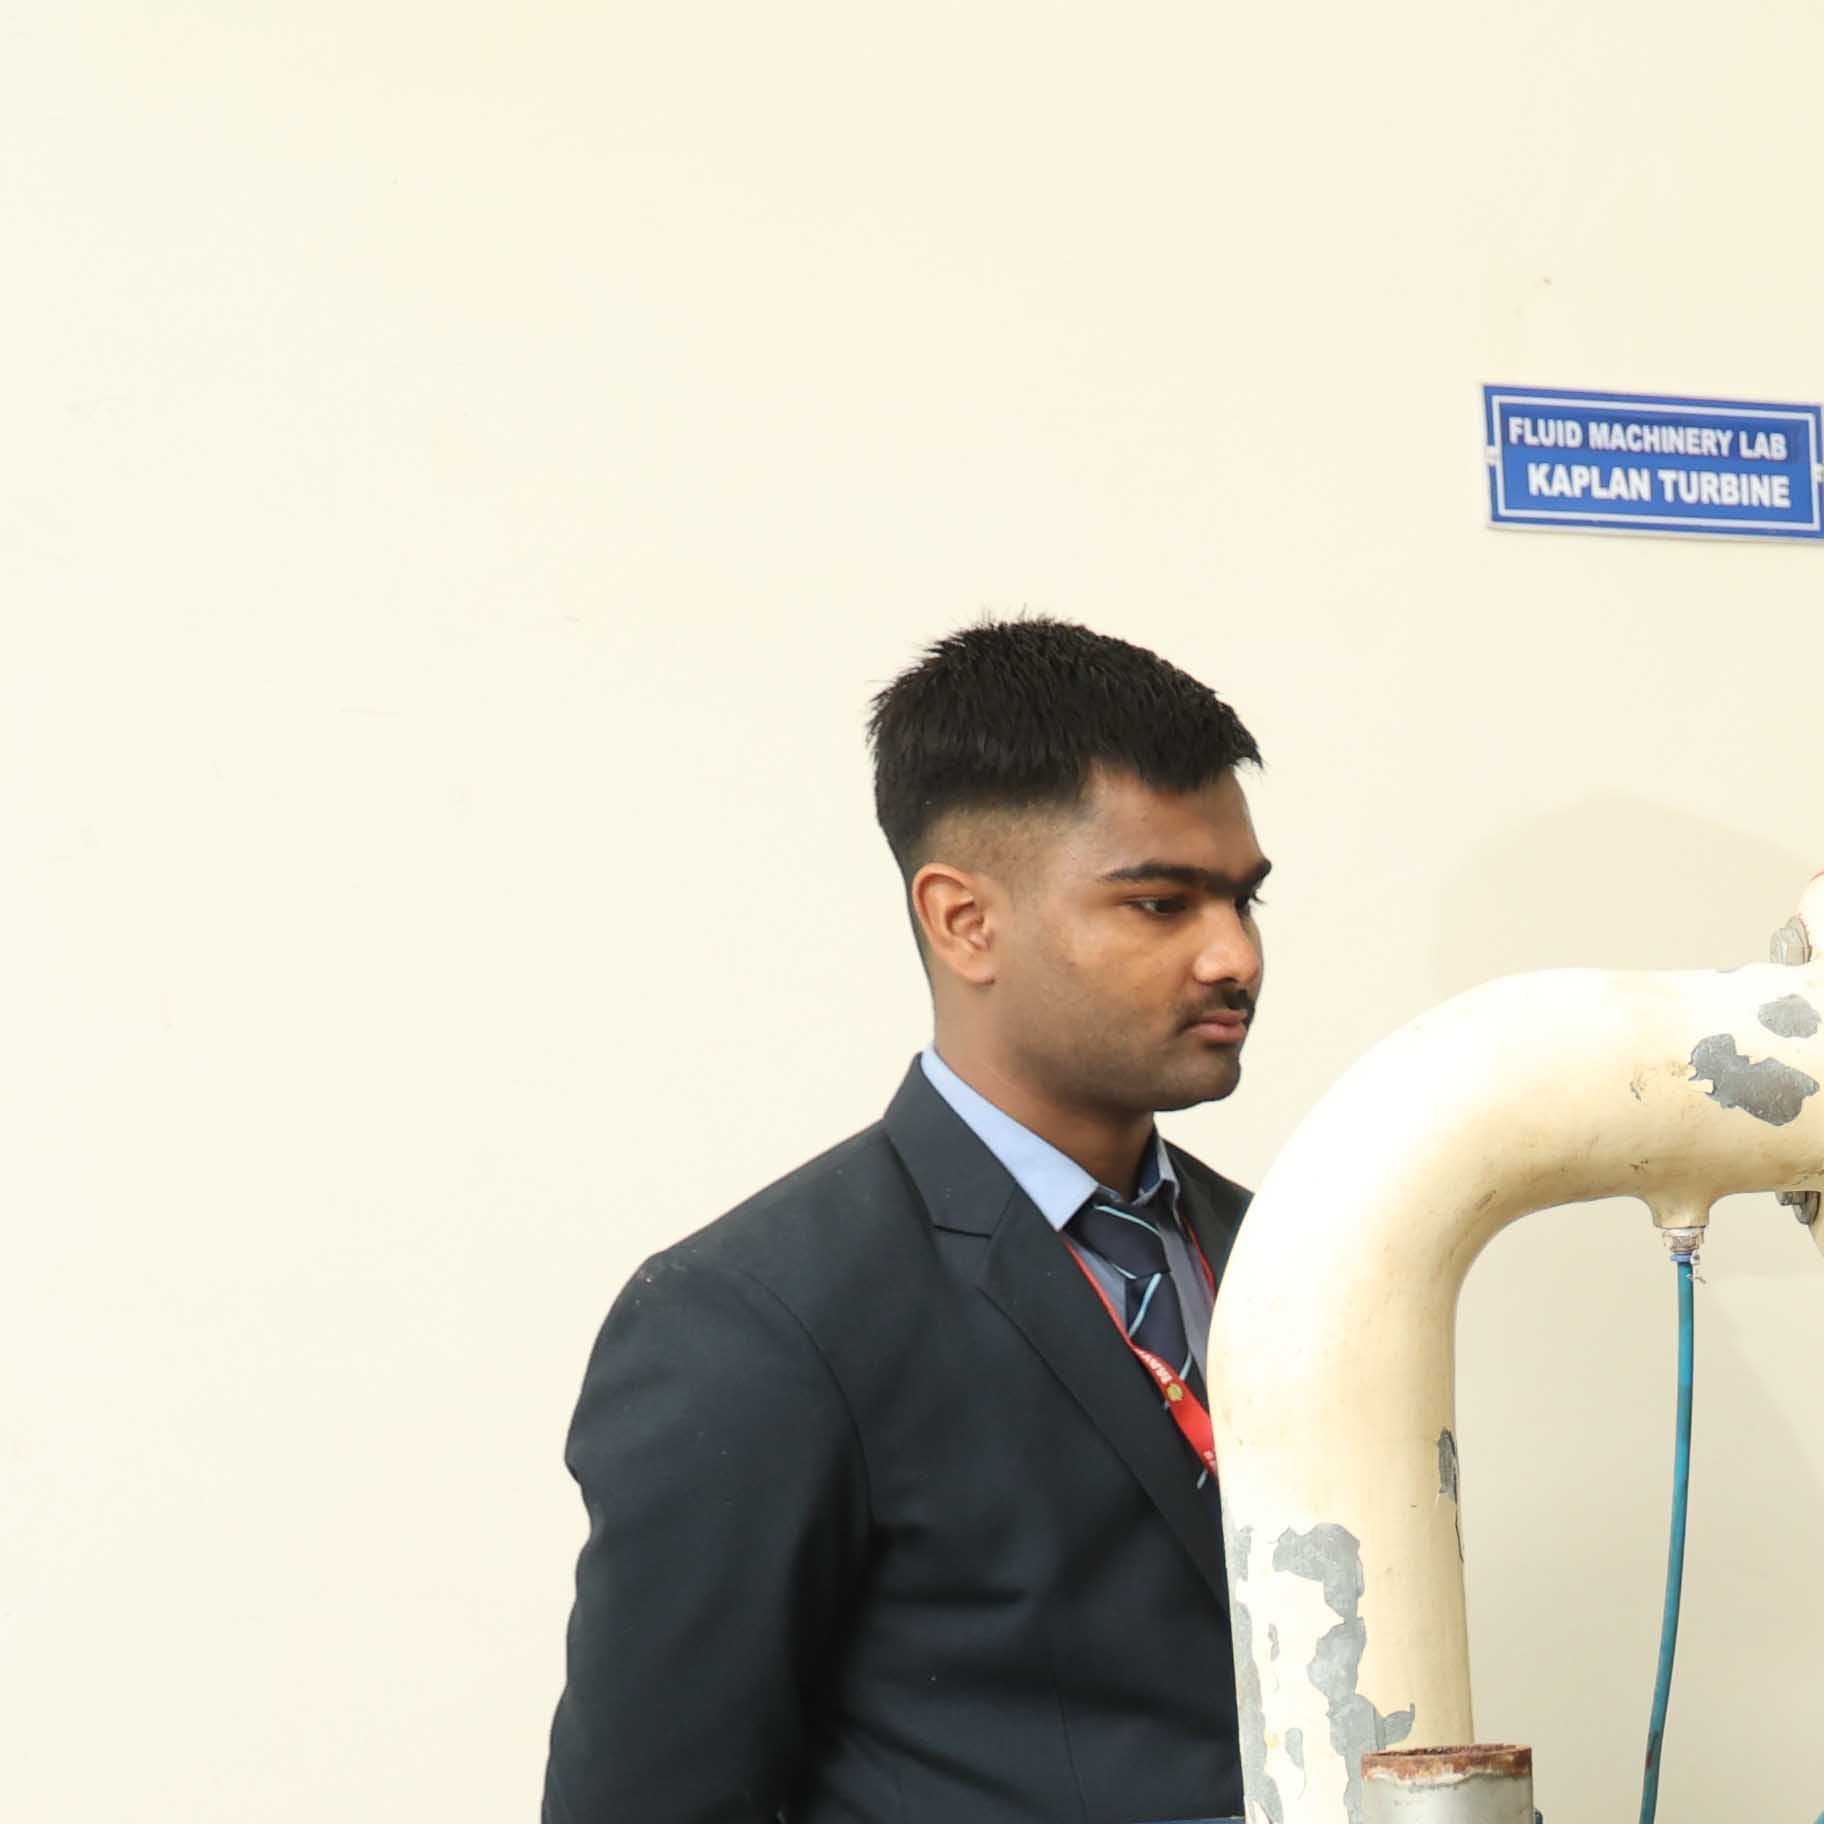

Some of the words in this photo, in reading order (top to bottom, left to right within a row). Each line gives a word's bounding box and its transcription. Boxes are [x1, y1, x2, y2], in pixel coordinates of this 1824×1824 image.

[1508, 417, 1582, 448] FLUID
[1588, 422, 1732, 456] MACHINERY
[1738, 431, 1788, 460] LAB
[1527, 462, 1651, 501] KAPLAN
[1657, 470, 1791, 509] TURBINE
